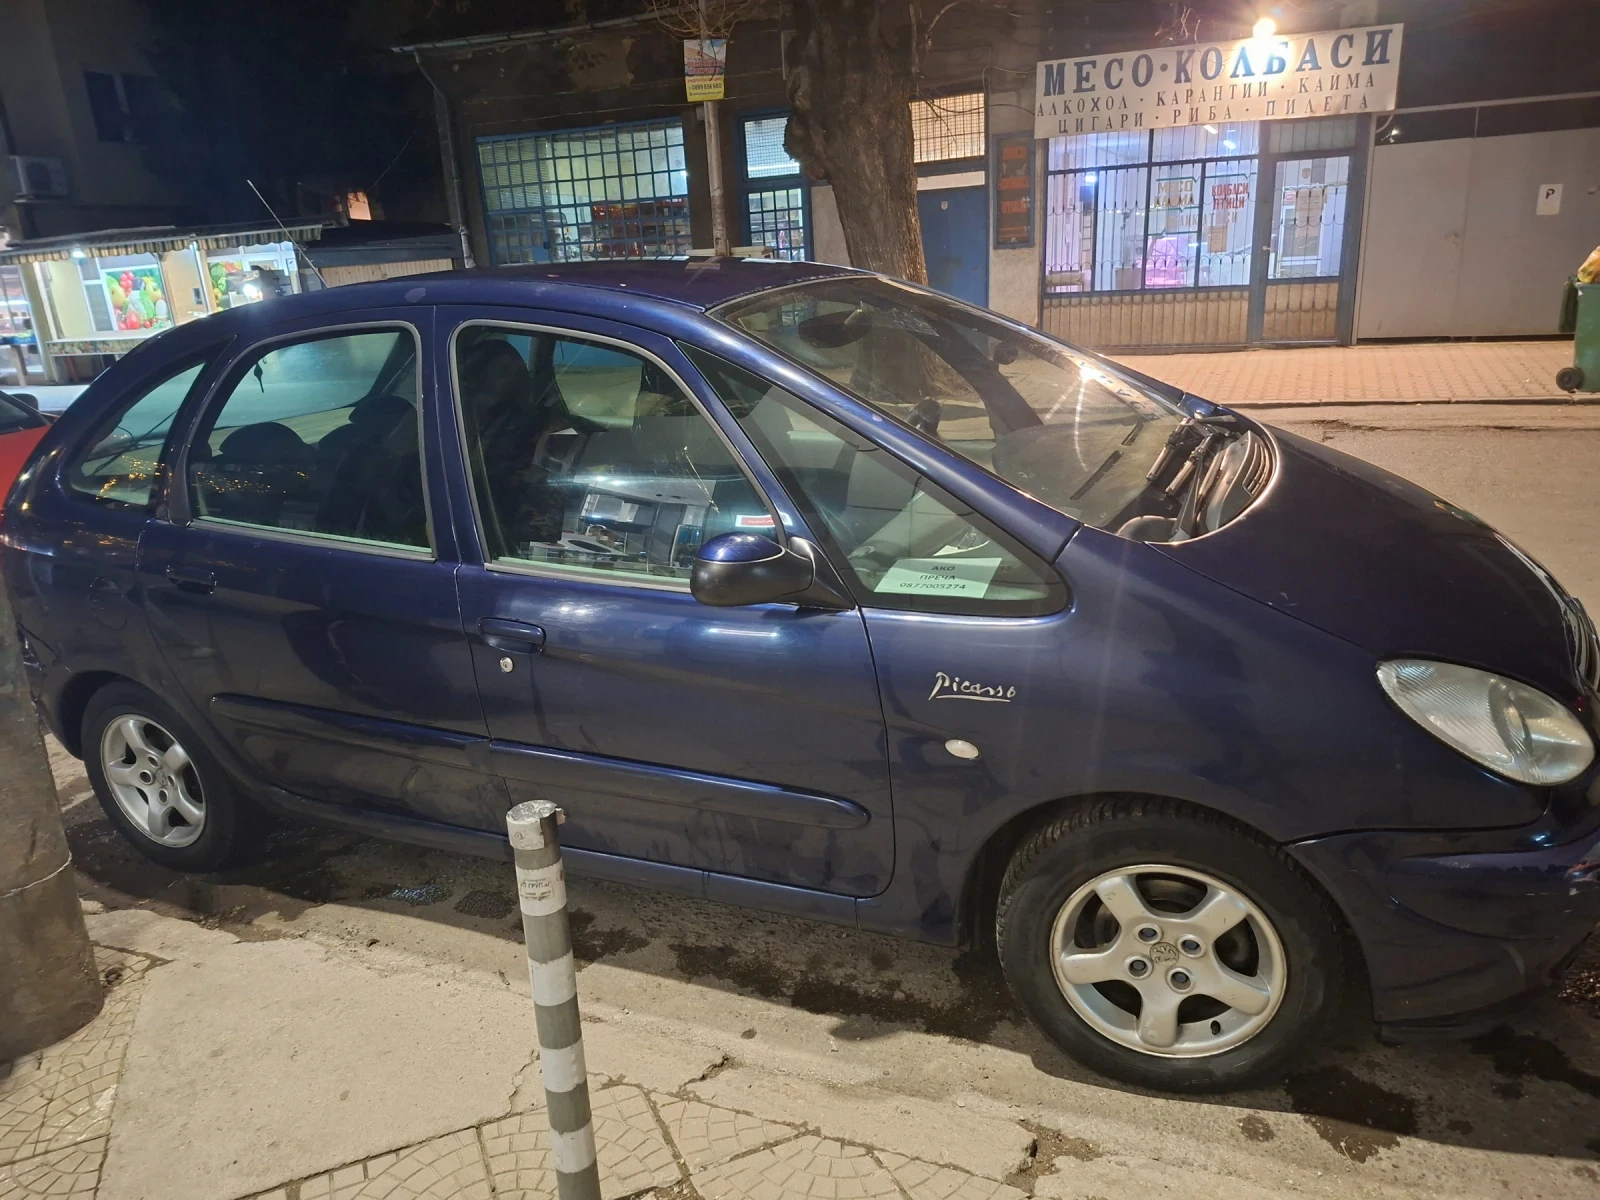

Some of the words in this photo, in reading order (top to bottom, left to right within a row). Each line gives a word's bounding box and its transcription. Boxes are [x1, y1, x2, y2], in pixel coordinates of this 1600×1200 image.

[1043, 53, 1154, 97] МЕСО
[1174, 28, 1394, 84] КОЛБАСИ
[1037, 94, 1128, 117] АЛКОХОЛ
[1298, 71, 1375, 94] КАЙМА
[1058, 112, 1144, 134] ЦИГАРИ
[1172, 105, 1232, 124] РИБА
[1265, 93, 1369, 116] ПИЛЕТА
[1157, 180, 1194, 194] МСО
[1211, 182, 1249, 197] КОЛБАСИ
[1545, 188, 1555, 199] P
[1154, 193, 1195, 208] КАМА
[899, 582, 967, 591] 0877005274
[928, 671, 1017, 702] Picasso
